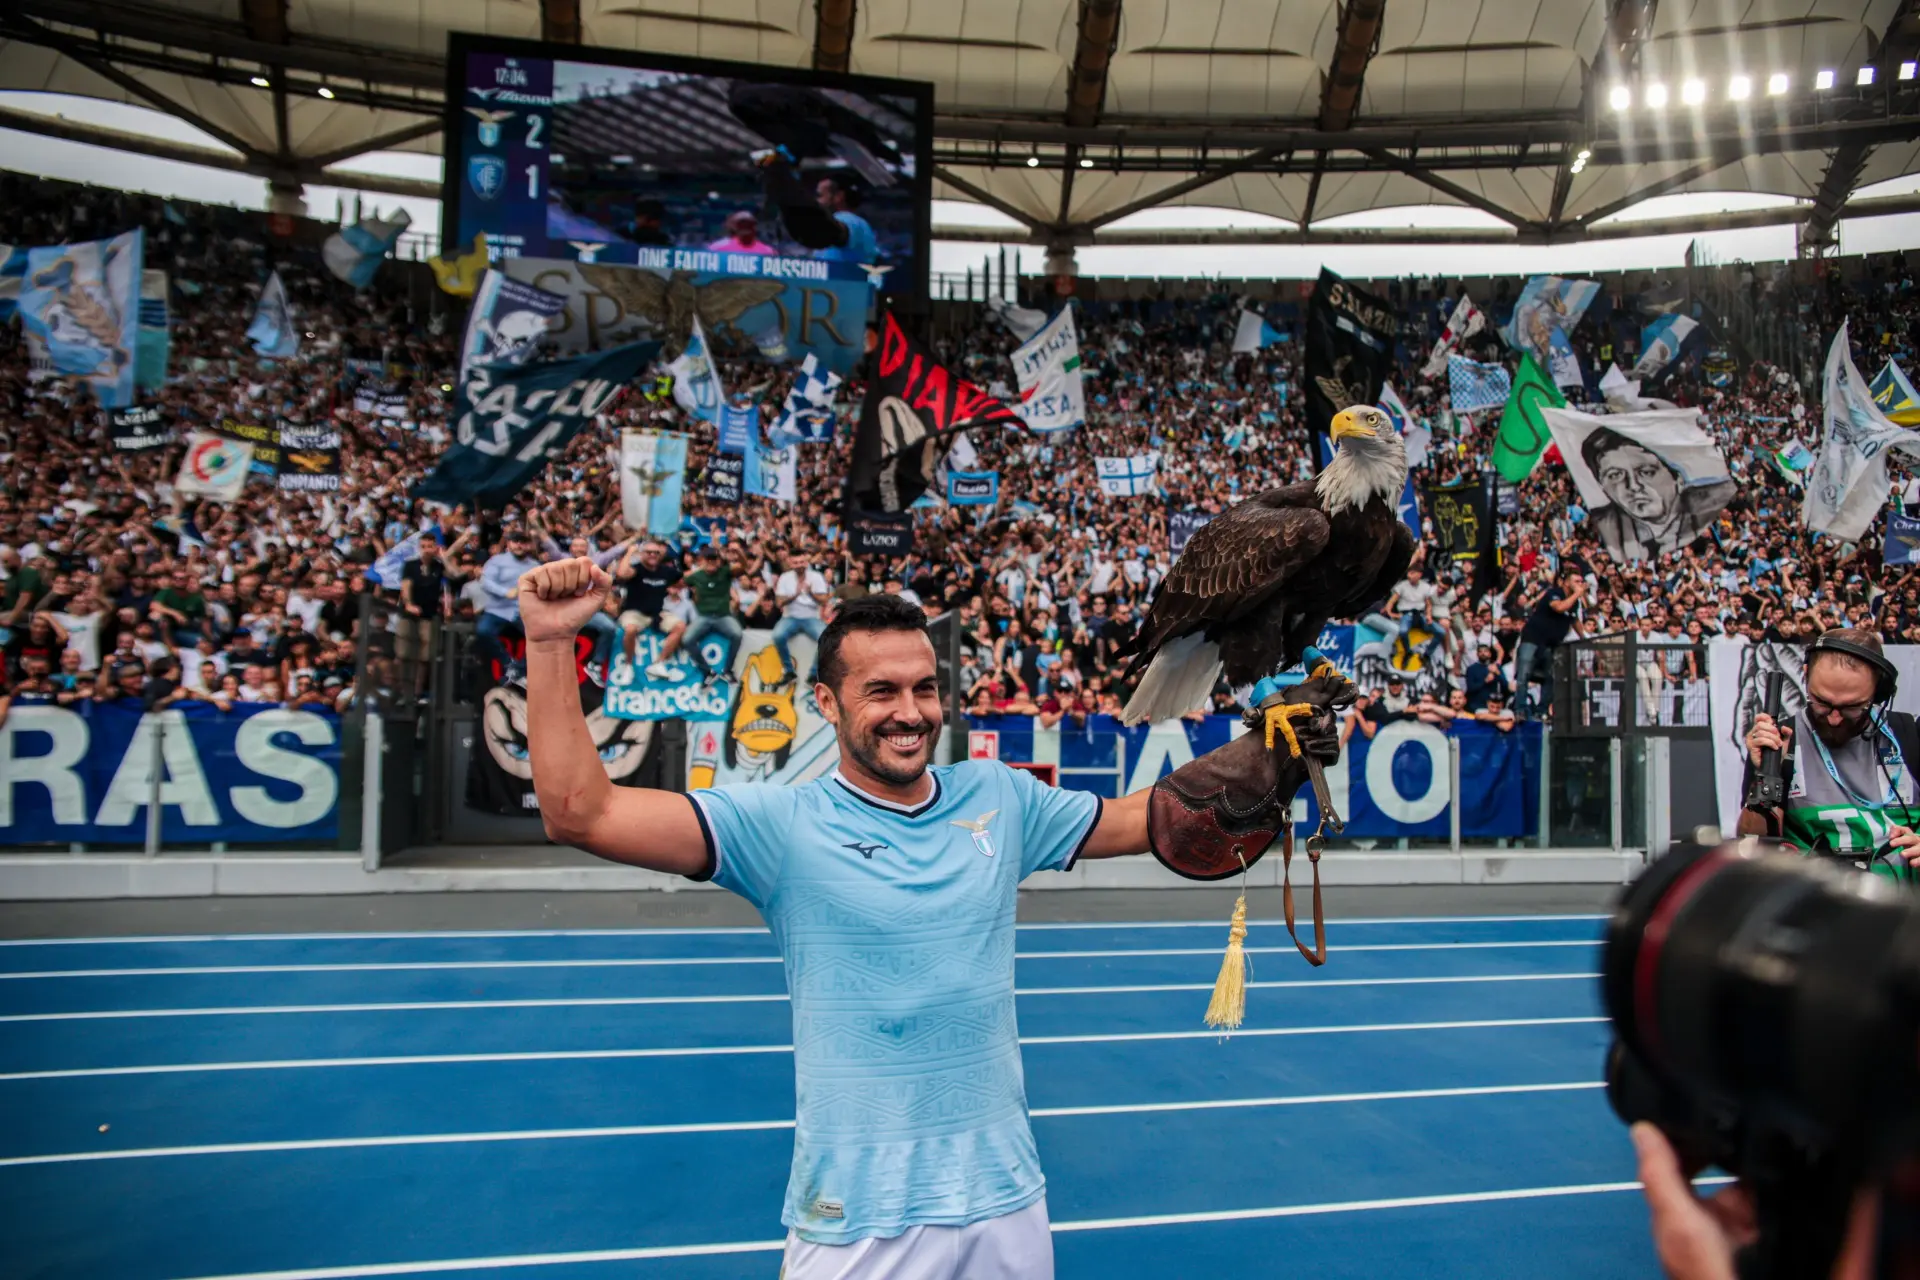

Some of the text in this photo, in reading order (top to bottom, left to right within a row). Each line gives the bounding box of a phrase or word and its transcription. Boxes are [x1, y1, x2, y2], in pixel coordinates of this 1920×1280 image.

[525, 114, 544, 149] 2
[525, 164, 539, 200] 1
[637, 247, 829, 281] ONE FAITH ONE PASSION
[606, 682, 727, 716] Francesco
[1818, 808, 1891, 852] TV
